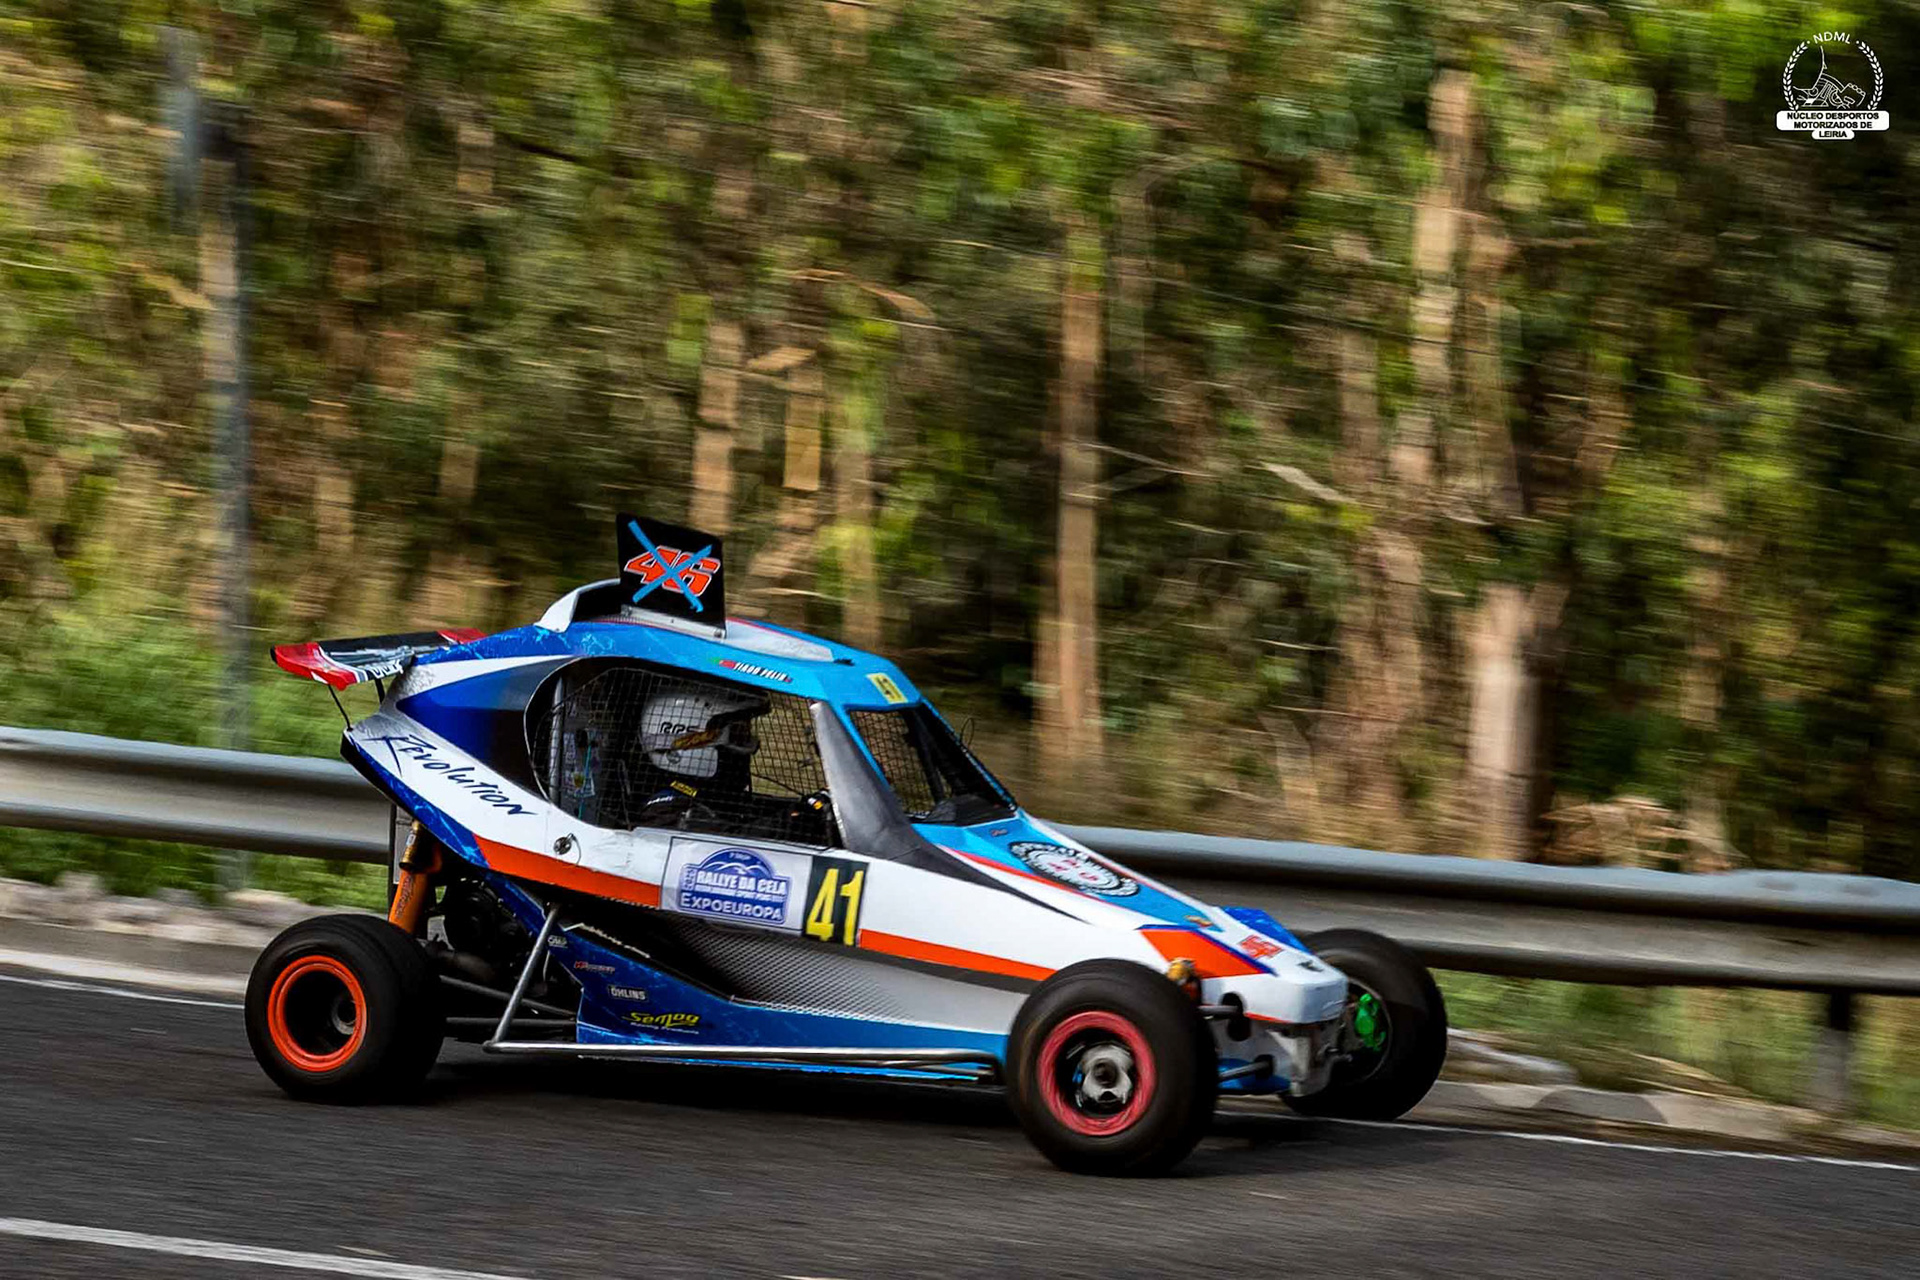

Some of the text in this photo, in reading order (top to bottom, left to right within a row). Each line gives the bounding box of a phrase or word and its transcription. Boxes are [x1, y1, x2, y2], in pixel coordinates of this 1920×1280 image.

[624, 545, 721, 597] 46
[697, 871, 738, 887] RALLYE
[738, 876, 756, 890] DA
[757, 878, 787, 894] CELA
[681, 893, 783, 919] EXPOEUROPA
[806, 868, 864, 946] 41
